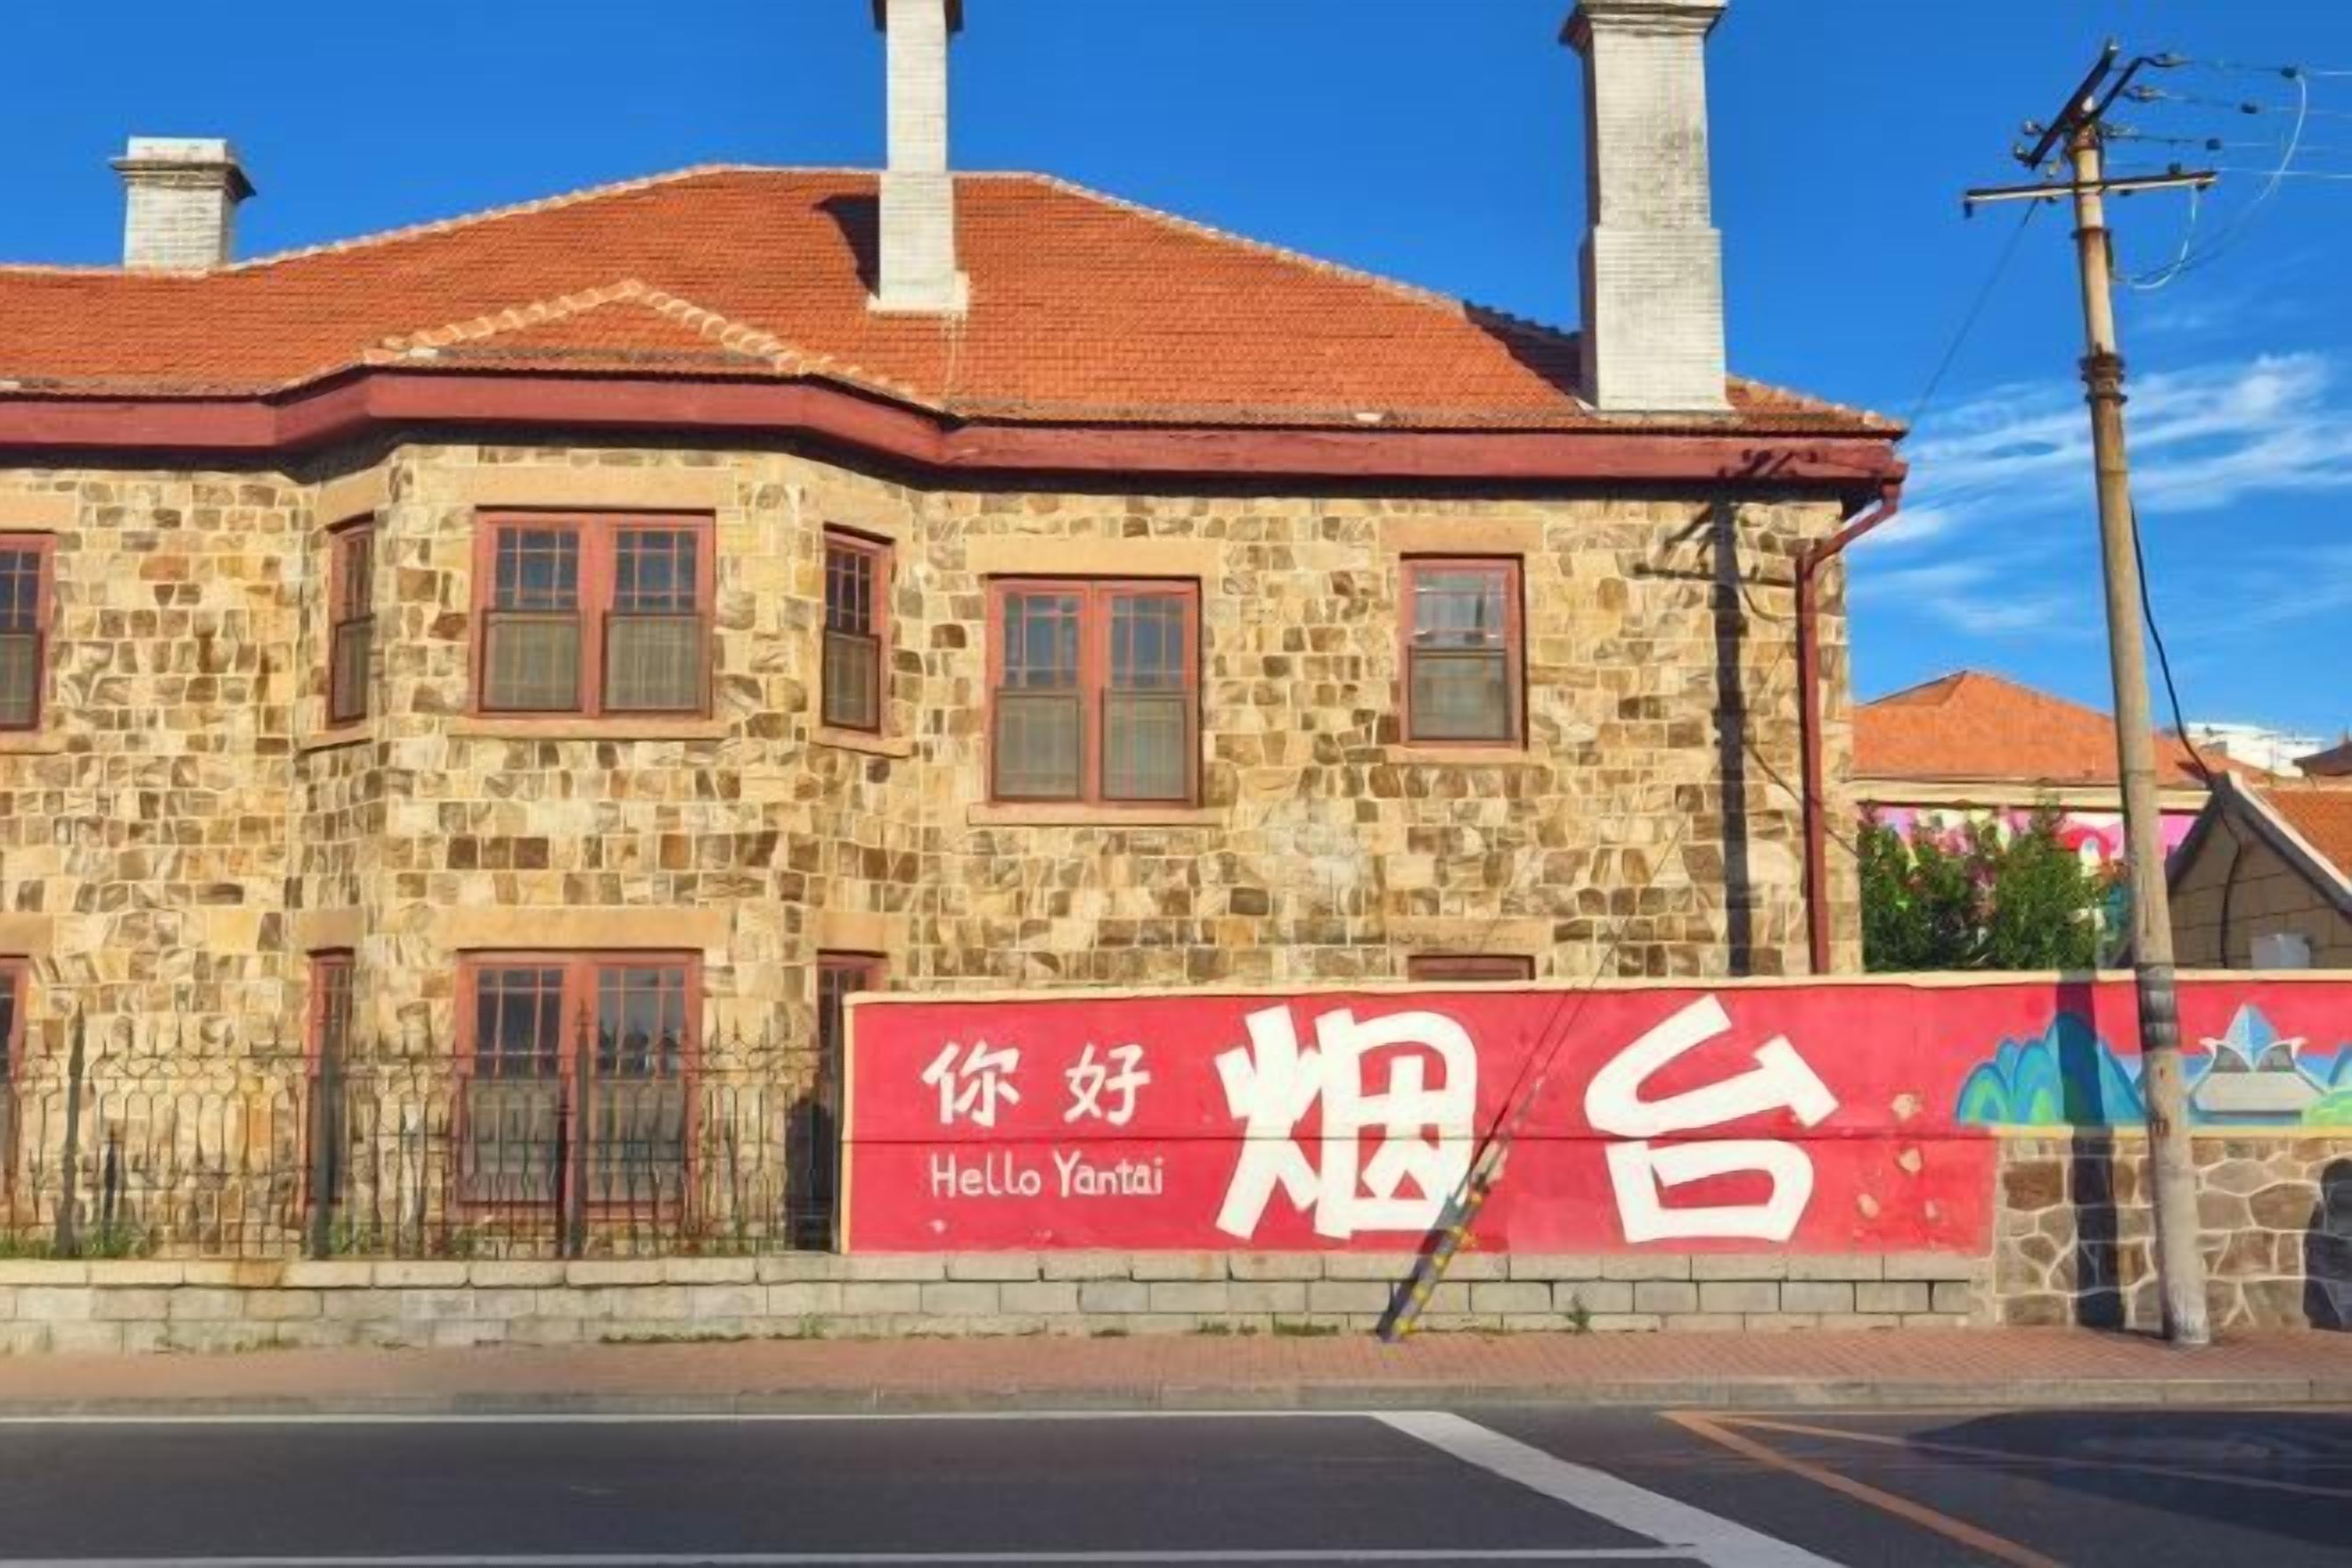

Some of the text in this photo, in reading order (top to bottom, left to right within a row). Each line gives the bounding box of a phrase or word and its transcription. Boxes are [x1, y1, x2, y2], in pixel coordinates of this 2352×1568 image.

[921, 1040, 1151, 1128] 你好
[1214, 993, 1840, 1245] 烟台
[930, 1149, 1164, 1197] Hello Yantai
